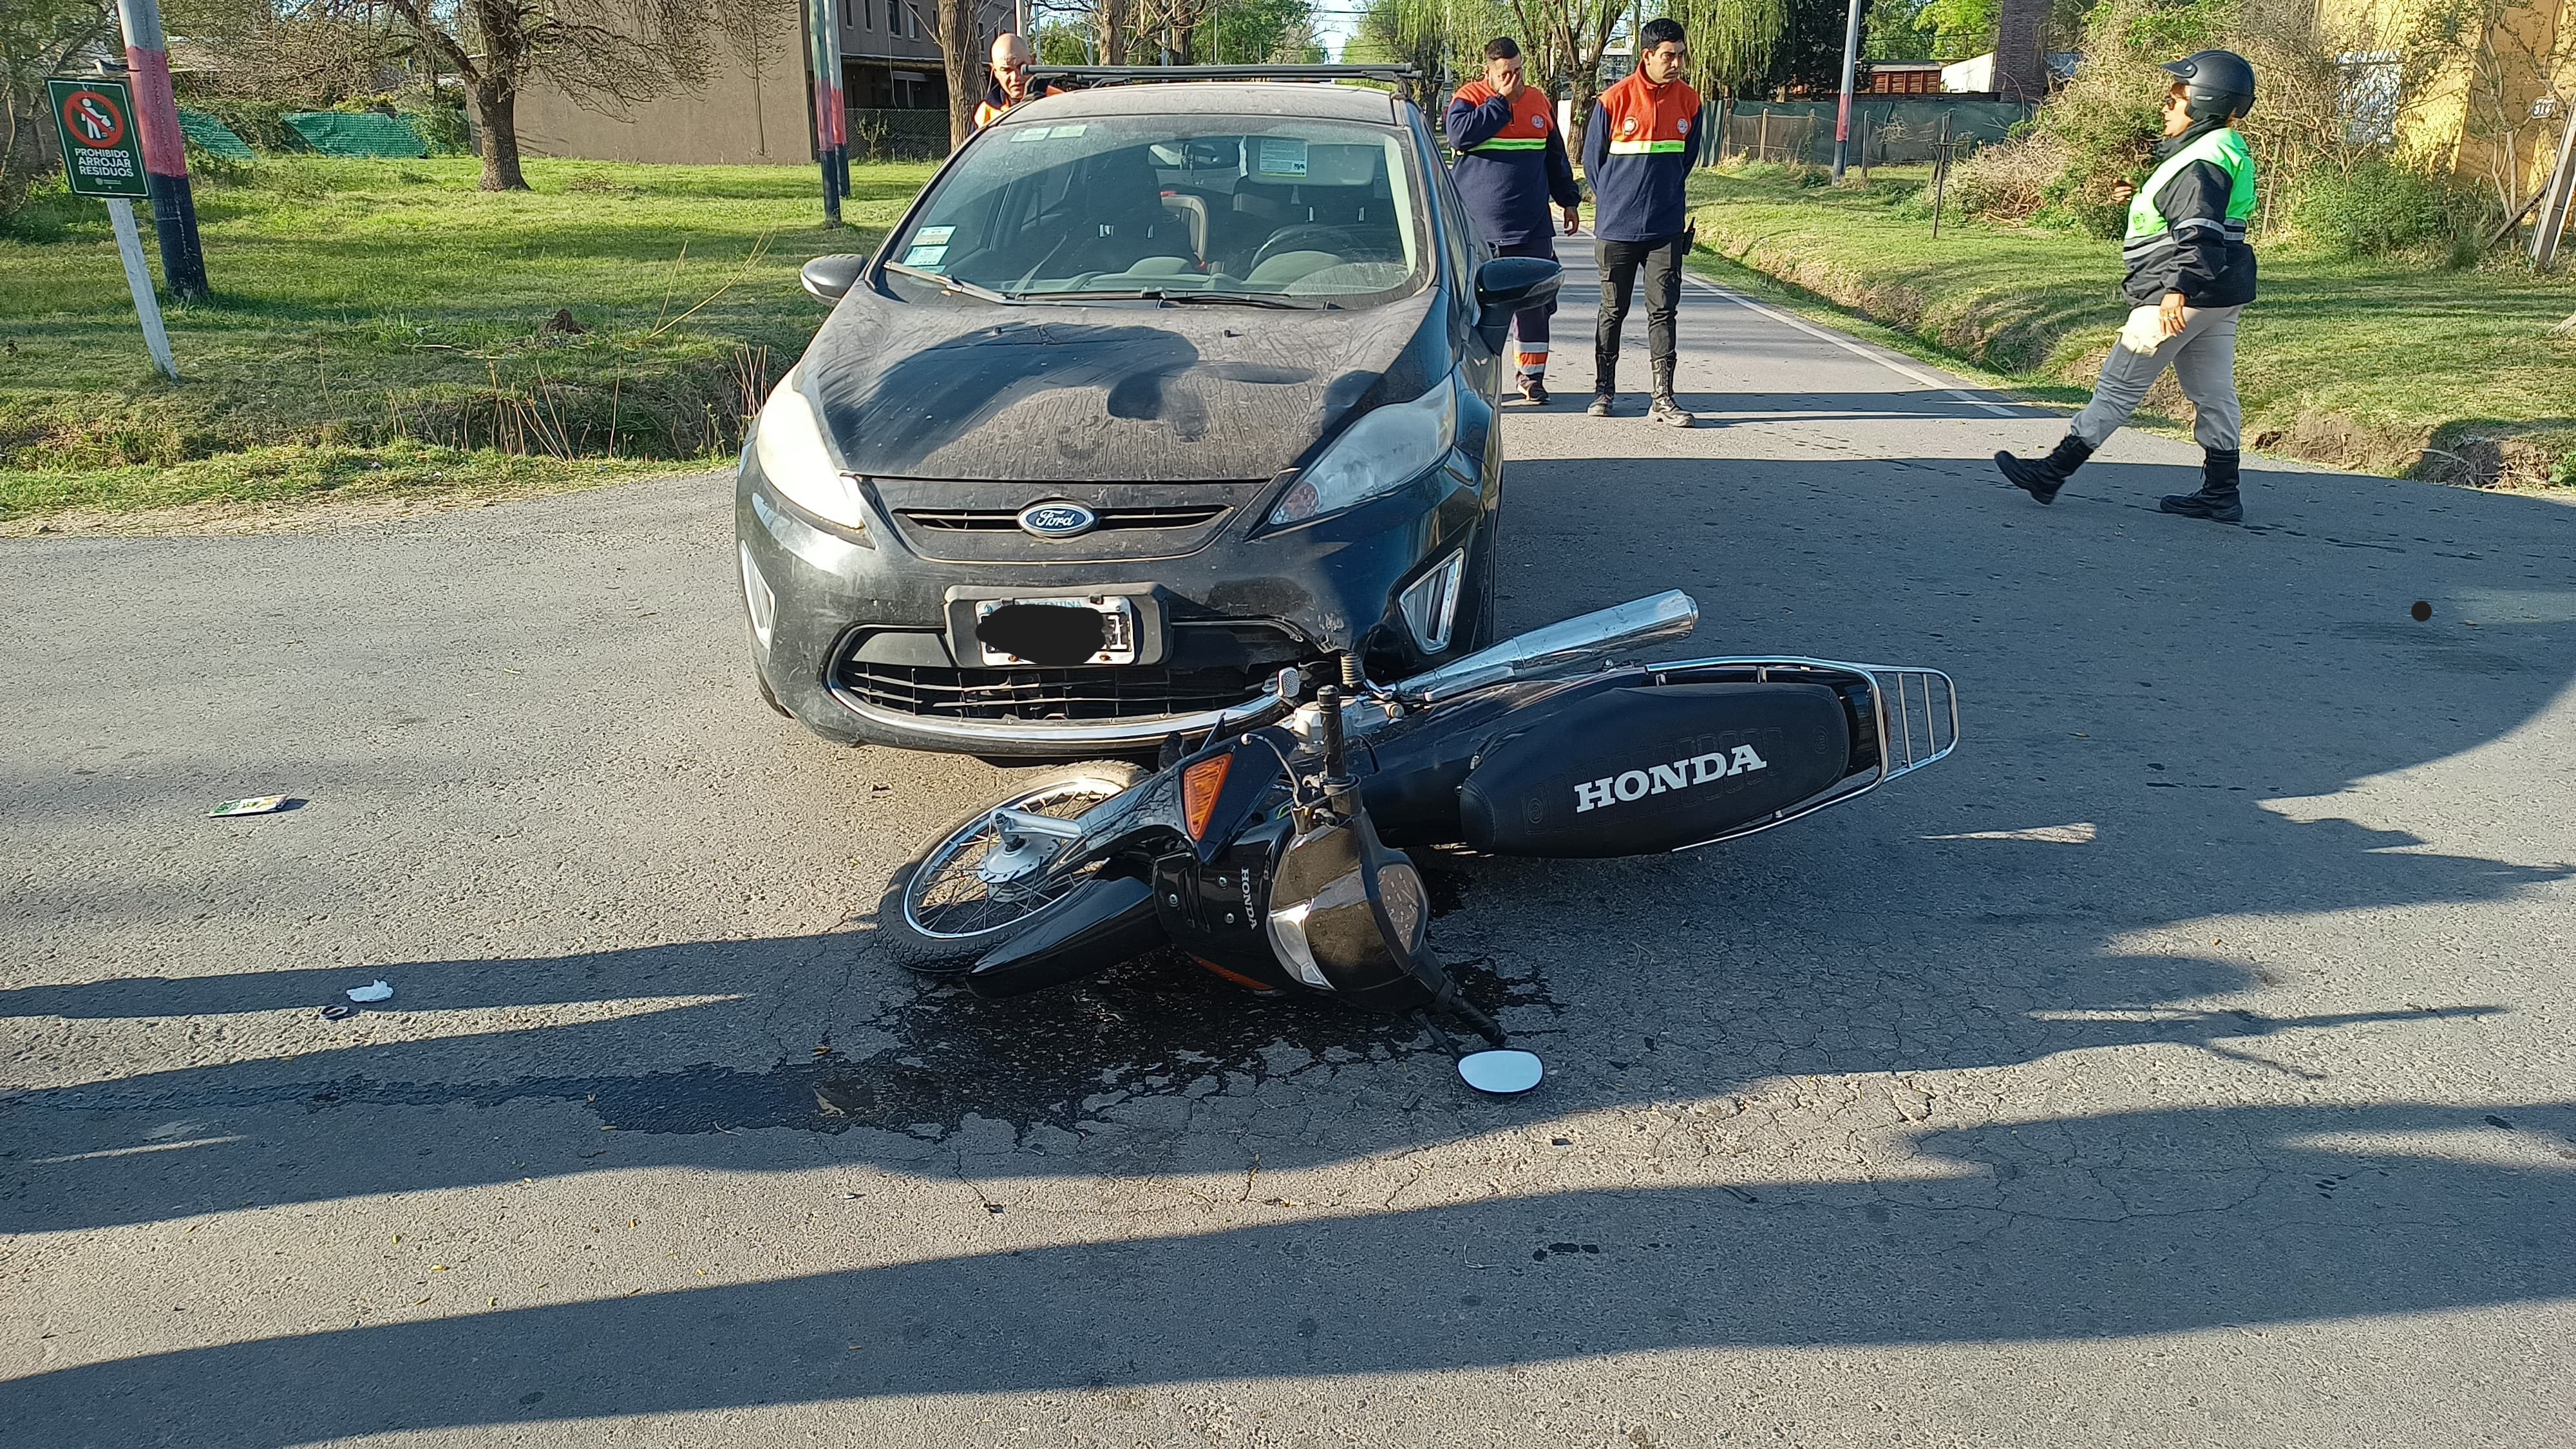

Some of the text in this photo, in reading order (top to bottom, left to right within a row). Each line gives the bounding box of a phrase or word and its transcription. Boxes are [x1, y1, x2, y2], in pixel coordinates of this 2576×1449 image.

[74, 148, 129, 158] PROHIBIDO
[79, 156, 132, 168] ARROJAR
[79, 166, 134, 177] RESIDUOS
[1036, 509, 1075, 526] Ford
[1574, 744, 1767, 813] HONDA
[1241, 867, 1258, 930] HONDA
